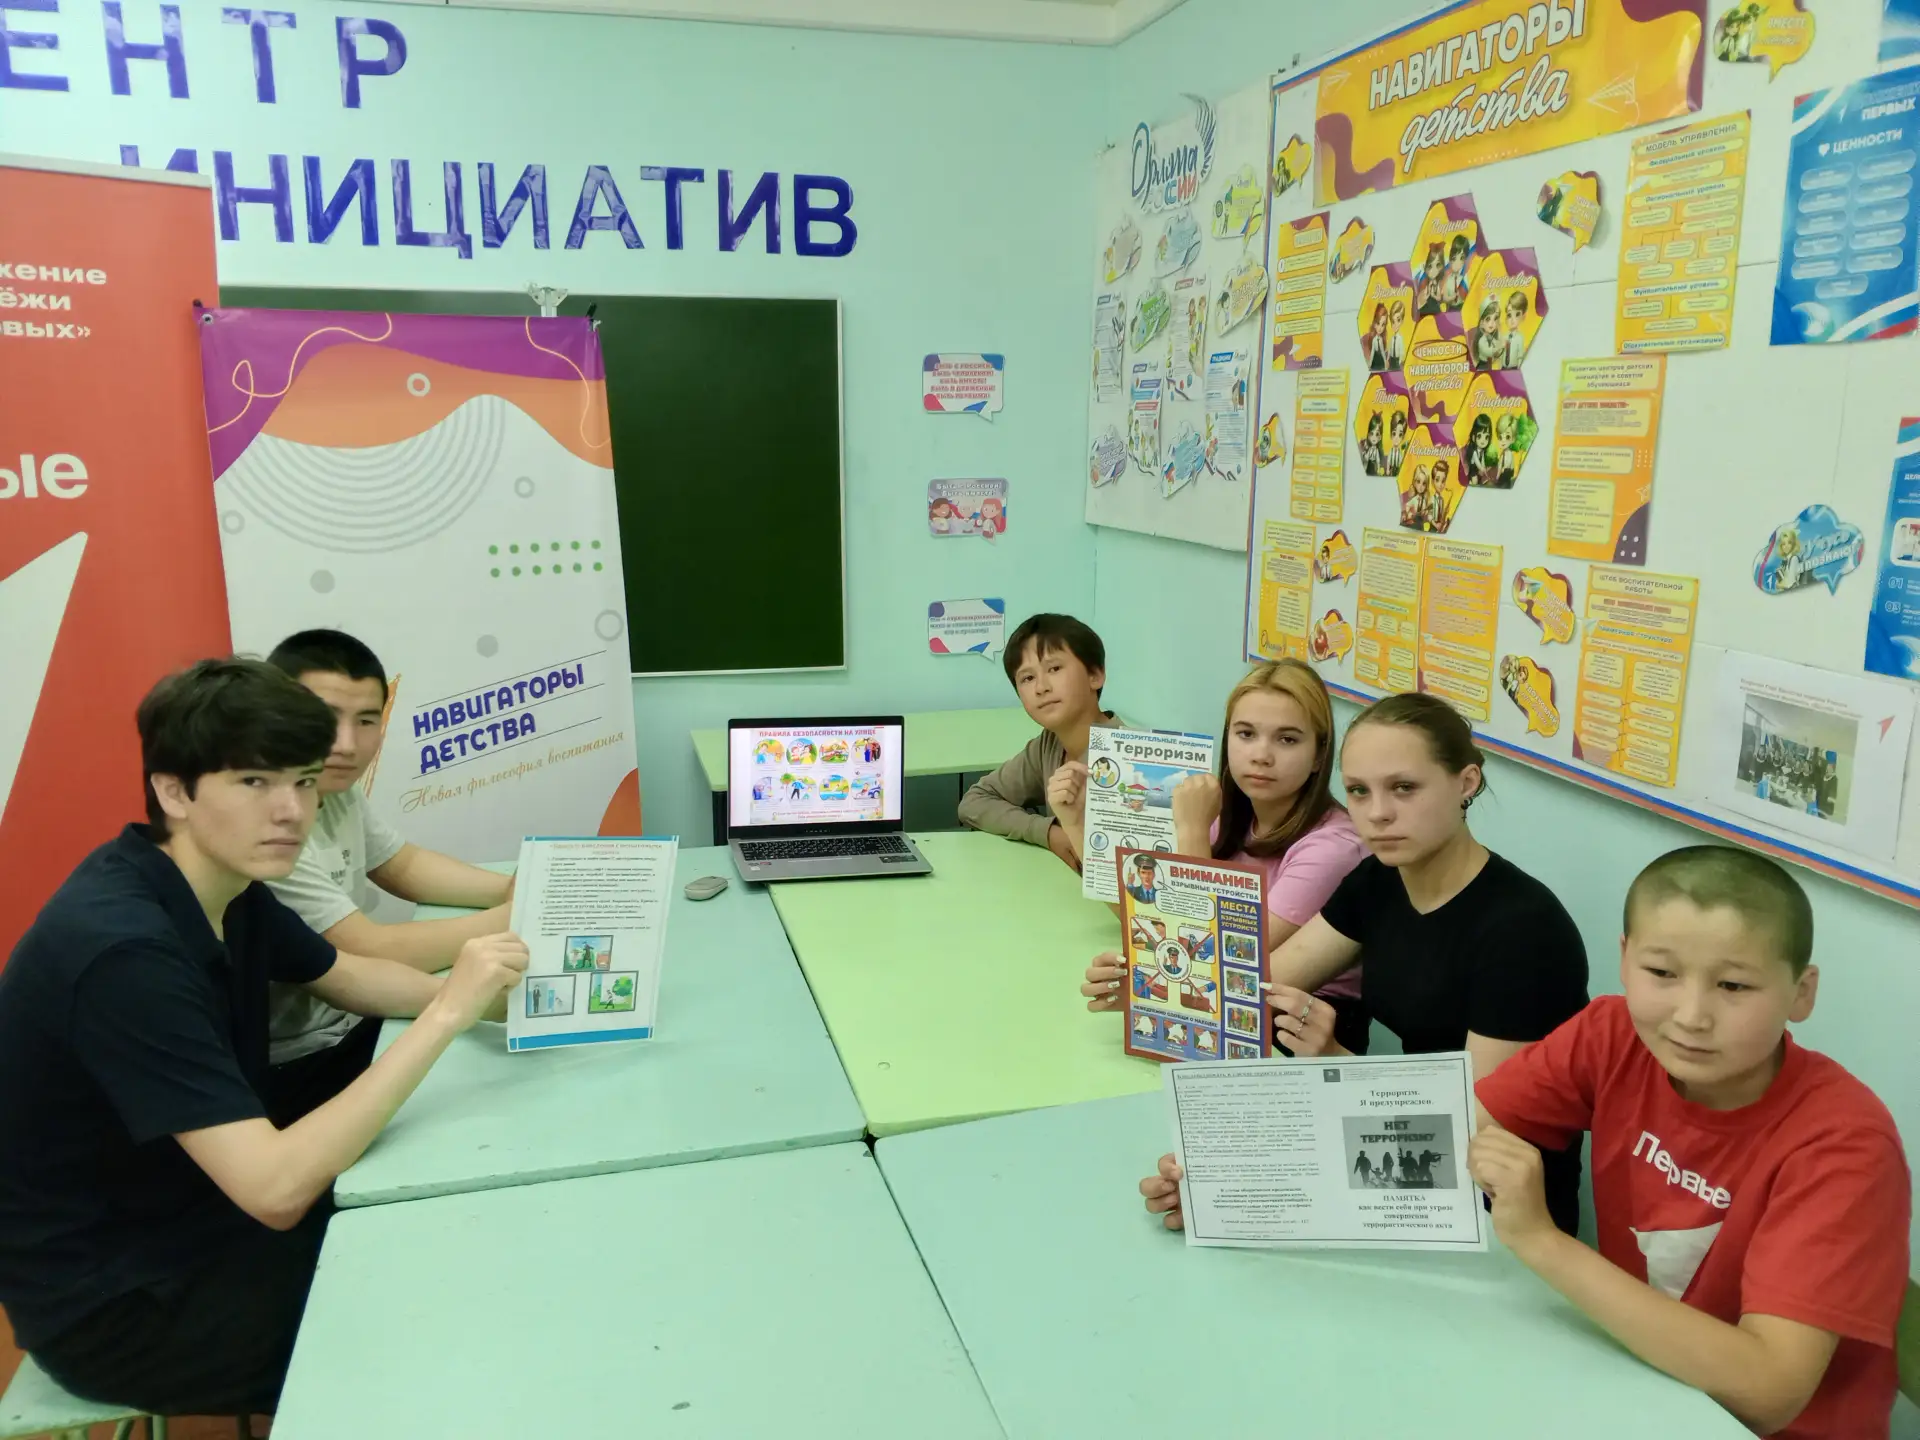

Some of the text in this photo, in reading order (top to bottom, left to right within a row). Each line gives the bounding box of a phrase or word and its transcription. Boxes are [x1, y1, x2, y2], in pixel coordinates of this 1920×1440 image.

[0, 0, 408, 109] ЕНТР
[1369, 0, 1586, 111] НАВИГАТОРЫ
[1400, 54, 1571, 173] детства
[1645, 124, 1738, 152] МОДЕЛЬ УПРАВЛЕНИЯ
[1833, 128, 1902, 154] ЦЕННОСТИ
[119, 144, 858, 258] НИЦИАТИВ
[0, 320, 91, 339] вых»
[1416, 344, 1463, 357] ЦЕННОСТИ
[1409, 361, 1470, 376] НАВИГАТОРОВ
[412, 664, 585, 738] НАВИГАТОРЫ
[420, 712, 536, 774] ДЕТСТВА
[1111, 732, 1177, 745] ПОДОЗРИТЕЛЬНЫЕ
[1114, 740, 1206, 763] Терроризм
[399, 732, 624, 813] Новая философия воспитания
[1171, 880, 1259, 901] ВЗРЫВНЫЕ УСТРОЙСТВА
[1220, 901, 1257, 914] МЕСТА
[1221, 915, 1258, 926] ВЗРЫВНЫХ
[1221, 922, 1258, 933] УСТРОЙСТВ
[1384, 1120, 1410, 1130] НЕТ
[1360, 1132, 1436, 1143] ТЕРРОРИЗМУ
[1383, 1194, 1426, 1202] ПАМЯТКА
